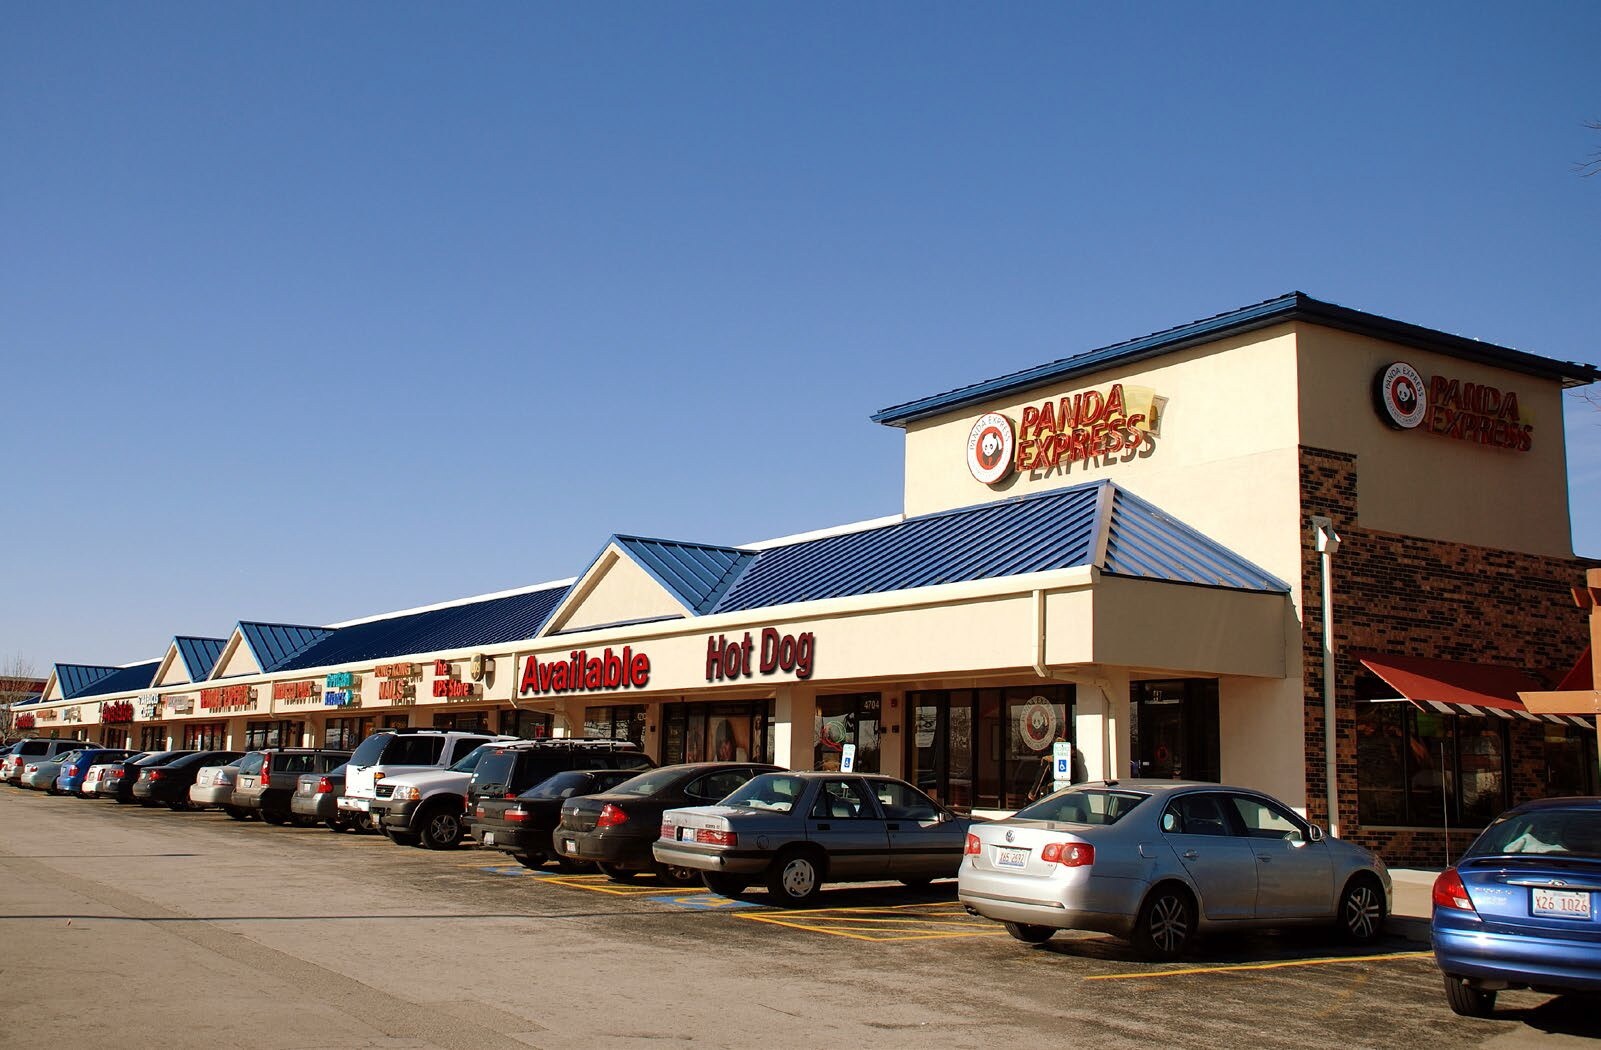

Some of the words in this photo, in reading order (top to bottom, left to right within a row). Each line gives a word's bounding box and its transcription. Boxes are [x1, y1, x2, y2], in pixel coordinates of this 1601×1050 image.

[1385, 367, 1401, 390] PANDA
[1402, 366, 1424, 397] EXPRESS
[1430, 375, 1520, 421] PANDA
[1019, 383, 1127, 439] PANDA
[1427, 404, 1534, 451] EXPRESS
[969, 420, 987, 450] PANDA
[988, 415, 1011, 442] EXPRESS
[1015, 413, 1146, 472] EXPRESS
[434, 659, 449, 676] The
[520, 645, 650, 693] Available
[705, 632, 752, 680] Hot
[759, 627, 815, 679] Dog
[379, 680, 404, 700] NAILS
[448, 678, 470, 697] Store
[863, 699, 880, 710] 4704
[1535, 896, 1555, 911] X26
[1561, 899, 1588, 912] 1026
